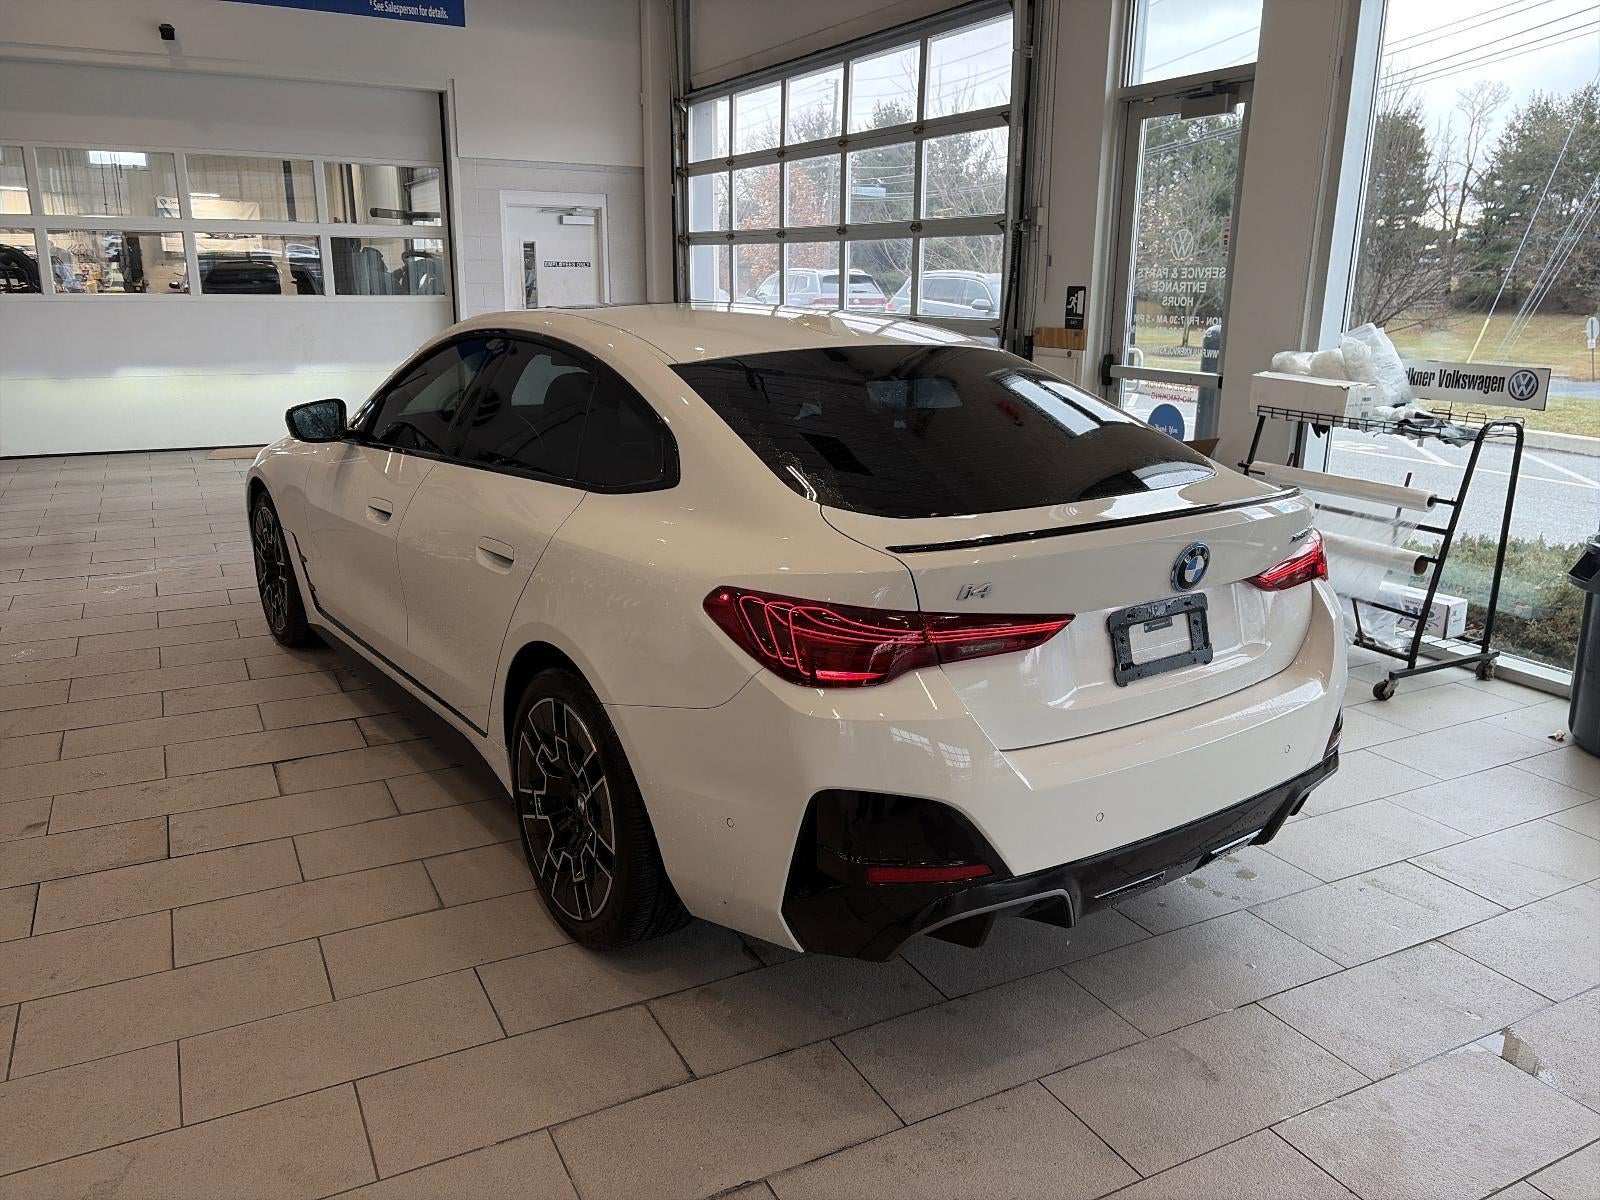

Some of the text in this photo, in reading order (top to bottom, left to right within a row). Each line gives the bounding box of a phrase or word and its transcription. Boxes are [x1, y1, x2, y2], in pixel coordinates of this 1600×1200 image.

[373, 0, 384, 11] See
[384, 1, 418, 16] Salesperson
[419, 5, 428, 16] for
[428, 6, 449, 19] details.
[1438, 368, 1505, 395] Volkswagen
[956, 581, 991, 601] i4
